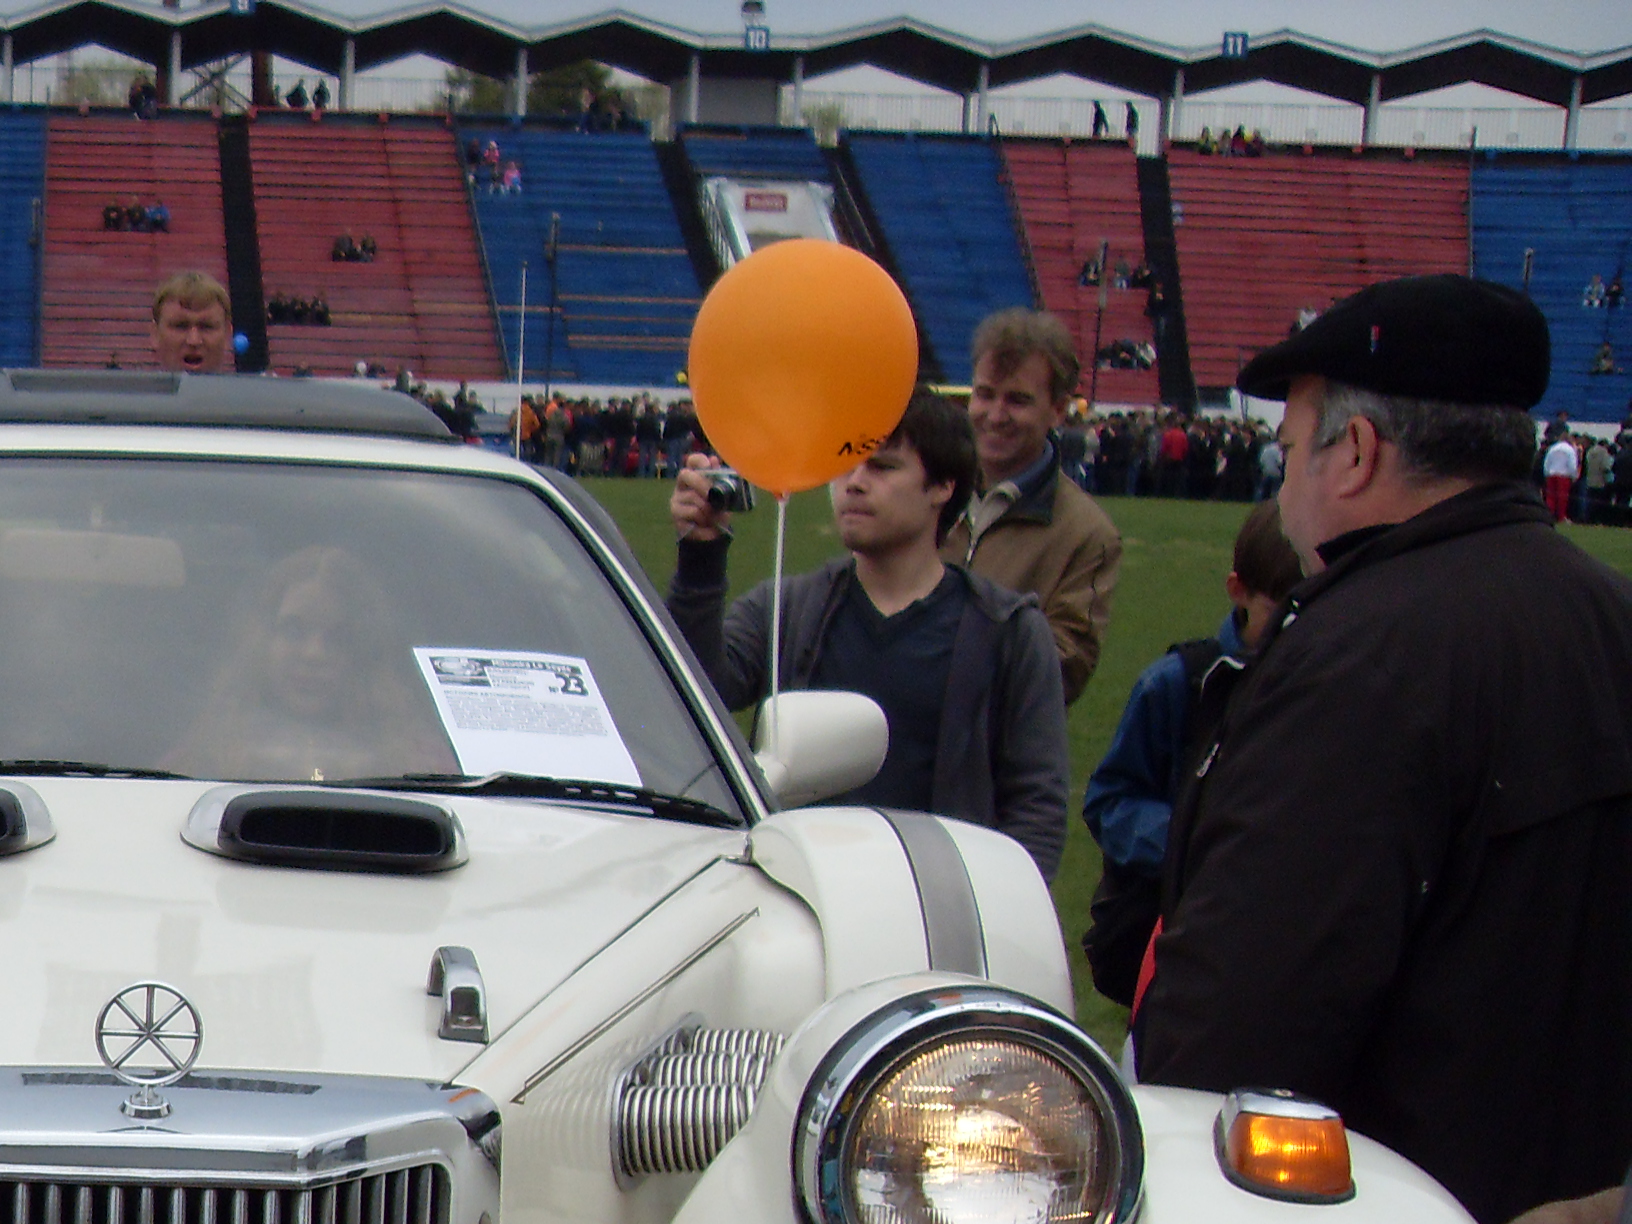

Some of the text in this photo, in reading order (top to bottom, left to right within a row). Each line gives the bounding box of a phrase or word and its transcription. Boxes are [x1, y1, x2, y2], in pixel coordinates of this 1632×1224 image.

[749, 30, 766, 50] 10
[1227, 36, 1243, 56] 11
[555, 673, 589, 697] 23
